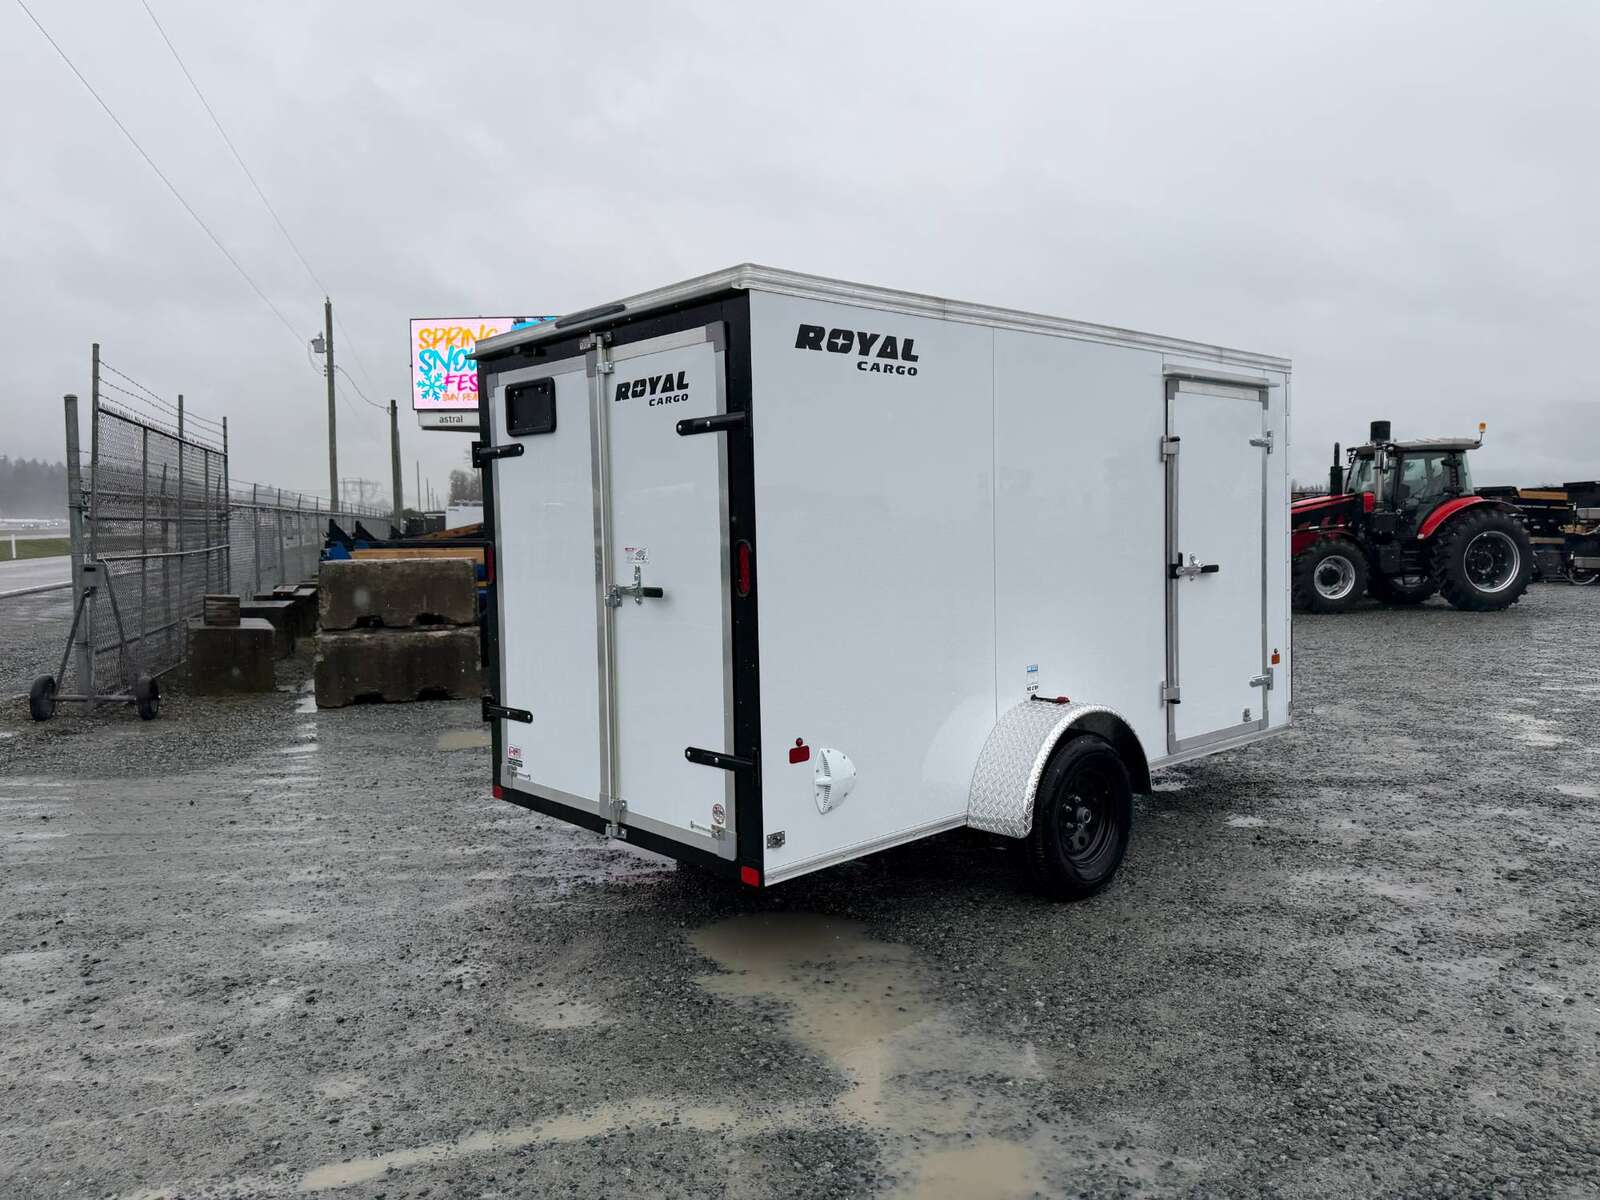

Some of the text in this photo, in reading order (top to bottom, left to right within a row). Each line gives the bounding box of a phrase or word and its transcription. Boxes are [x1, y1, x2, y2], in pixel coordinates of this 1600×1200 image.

[794, 323, 920, 363] ROYAL
[857, 361, 919, 377] CARGO
[614, 370, 690, 402] ROYAL
[648, 393, 689, 407] CARGO
[439, 415, 464, 424] astral
